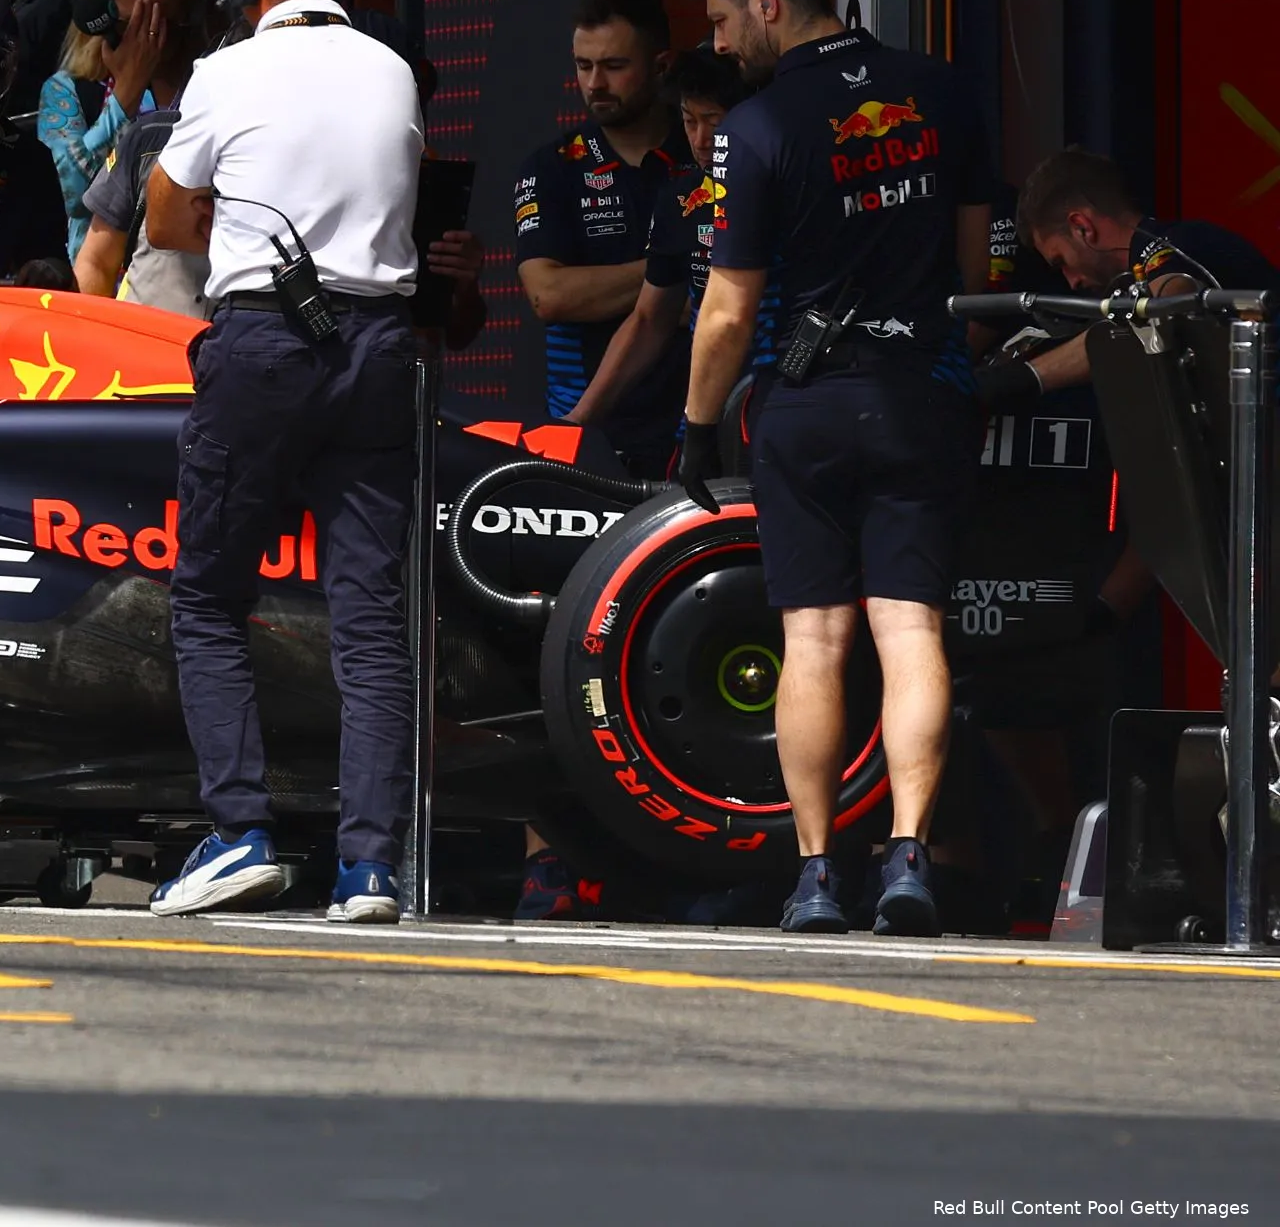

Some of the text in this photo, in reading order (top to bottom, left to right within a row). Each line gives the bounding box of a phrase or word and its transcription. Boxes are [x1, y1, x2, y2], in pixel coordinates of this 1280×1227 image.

[817, 37, 860, 53] HONDA
[588, 137, 604, 163] zoom
[831, 127, 940, 183] Red Bull
[581, 196, 611, 208] Mobil
[843, 178, 910, 218] Mobil
[583, 211, 624, 221] ORACLE
[700, 225, 714, 234] TA
[990, 231, 1016, 243] elcel
[700, 235, 714, 246] HEU
[990, 244, 1020, 256] OKT
[691, 263, 712, 272] ORA
[1048, 421, 1068, 464] 1
[32, 498, 317, 581] Red ul
[951, 579, 1037, 608] ayer
[961, 605, 1003, 636] 0.0
[592, 729, 718, 841] ZERO
